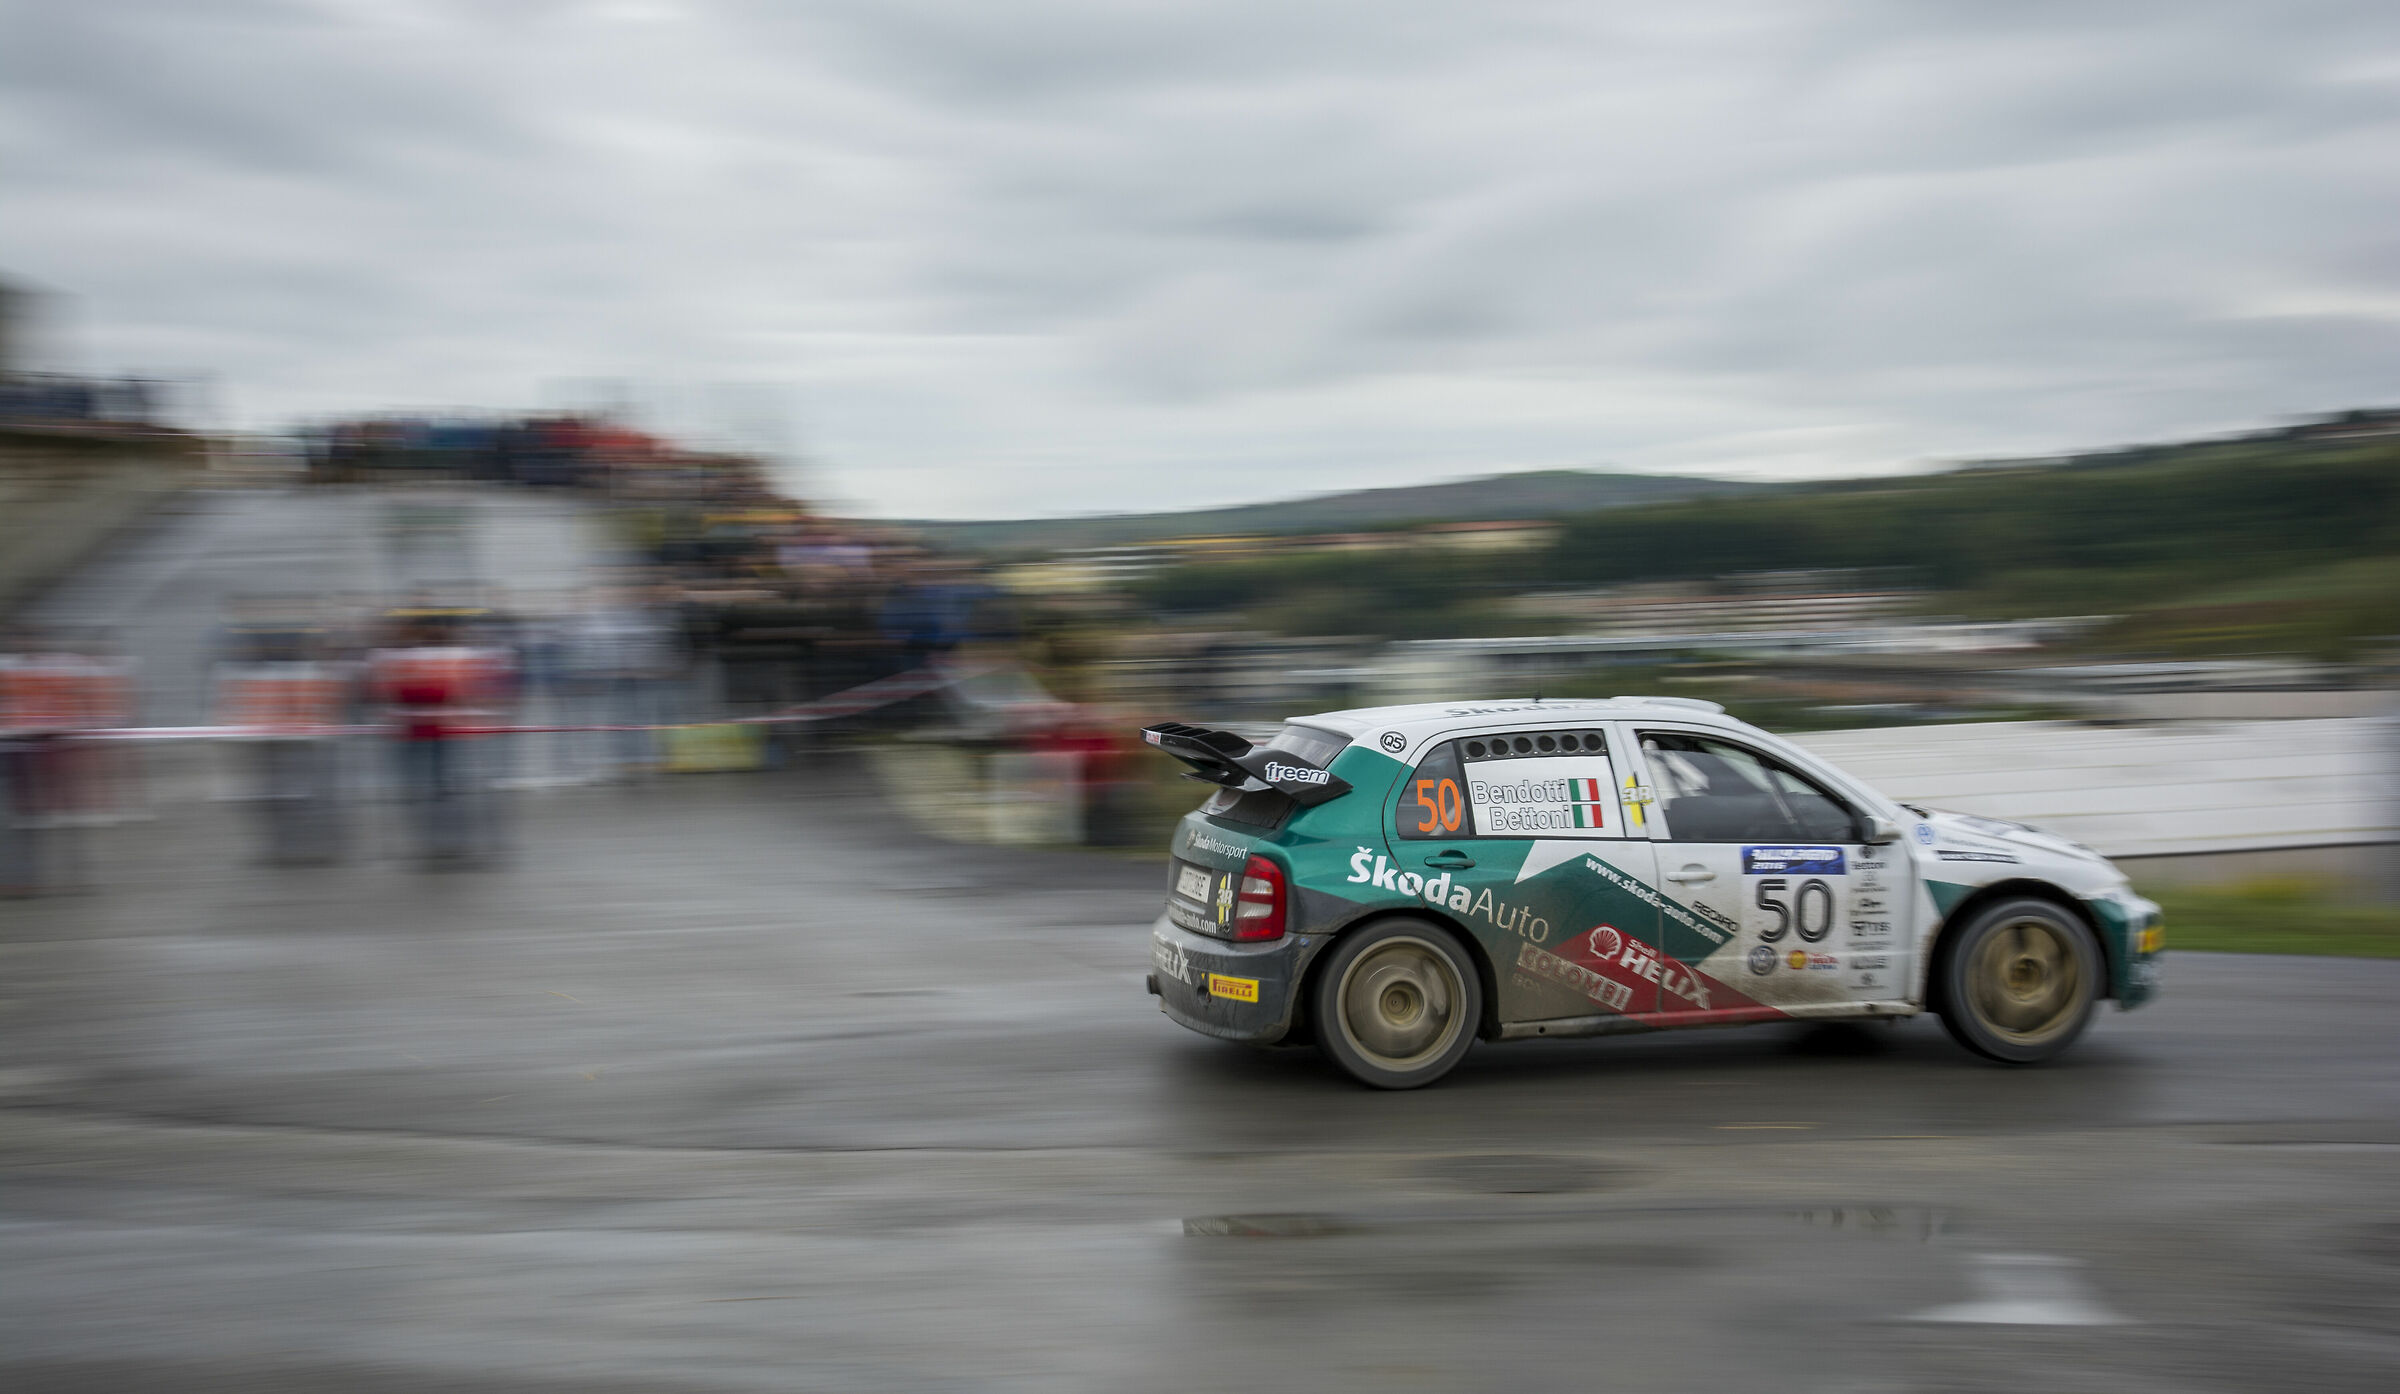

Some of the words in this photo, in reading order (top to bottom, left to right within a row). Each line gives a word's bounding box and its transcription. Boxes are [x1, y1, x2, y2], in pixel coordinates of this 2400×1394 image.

[1383, 734, 1403, 750] Q5
[1265, 762, 1330, 784] freem
[1471, 779, 1569, 805] Bendotti
[1416, 778, 1462, 833] 50
[1489, 804, 1572, 831] Bettoni
[1347, 846, 1549, 943] ŠkodaAuto
[1585, 856, 1726, 945] www.skoda-auto.com
[1756, 878, 1836, 944] 50
[1212, 978, 1254, 998] PIRELLI
[1619, 947, 1712, 1010] HELIX
